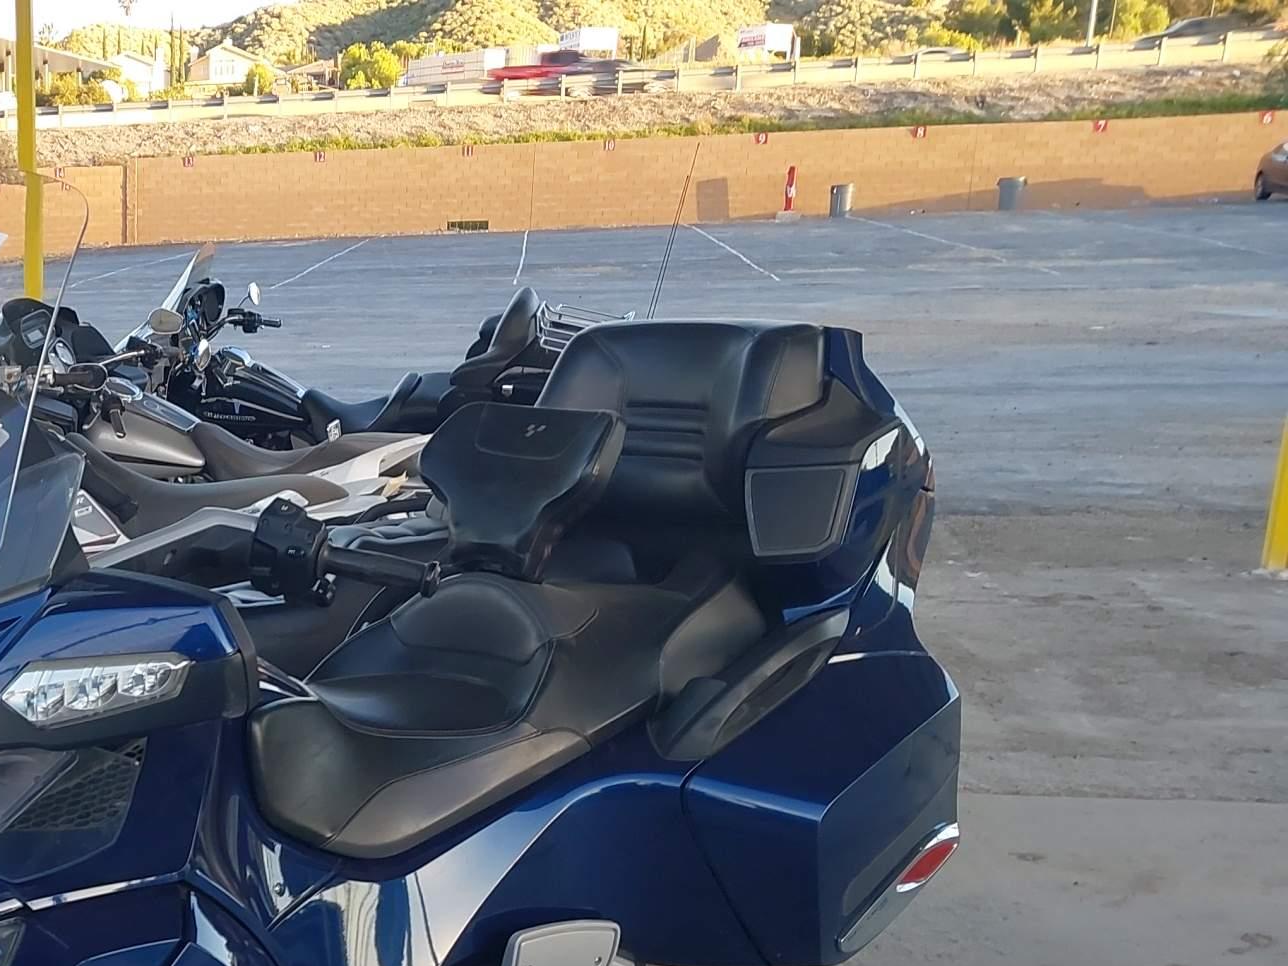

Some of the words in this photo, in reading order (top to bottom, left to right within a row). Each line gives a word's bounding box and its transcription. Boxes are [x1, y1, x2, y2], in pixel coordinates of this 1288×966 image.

[463, 145, 473, 157] 11
[604, 139, 615, 151] 10
[314, 151, 325, 163] 12
